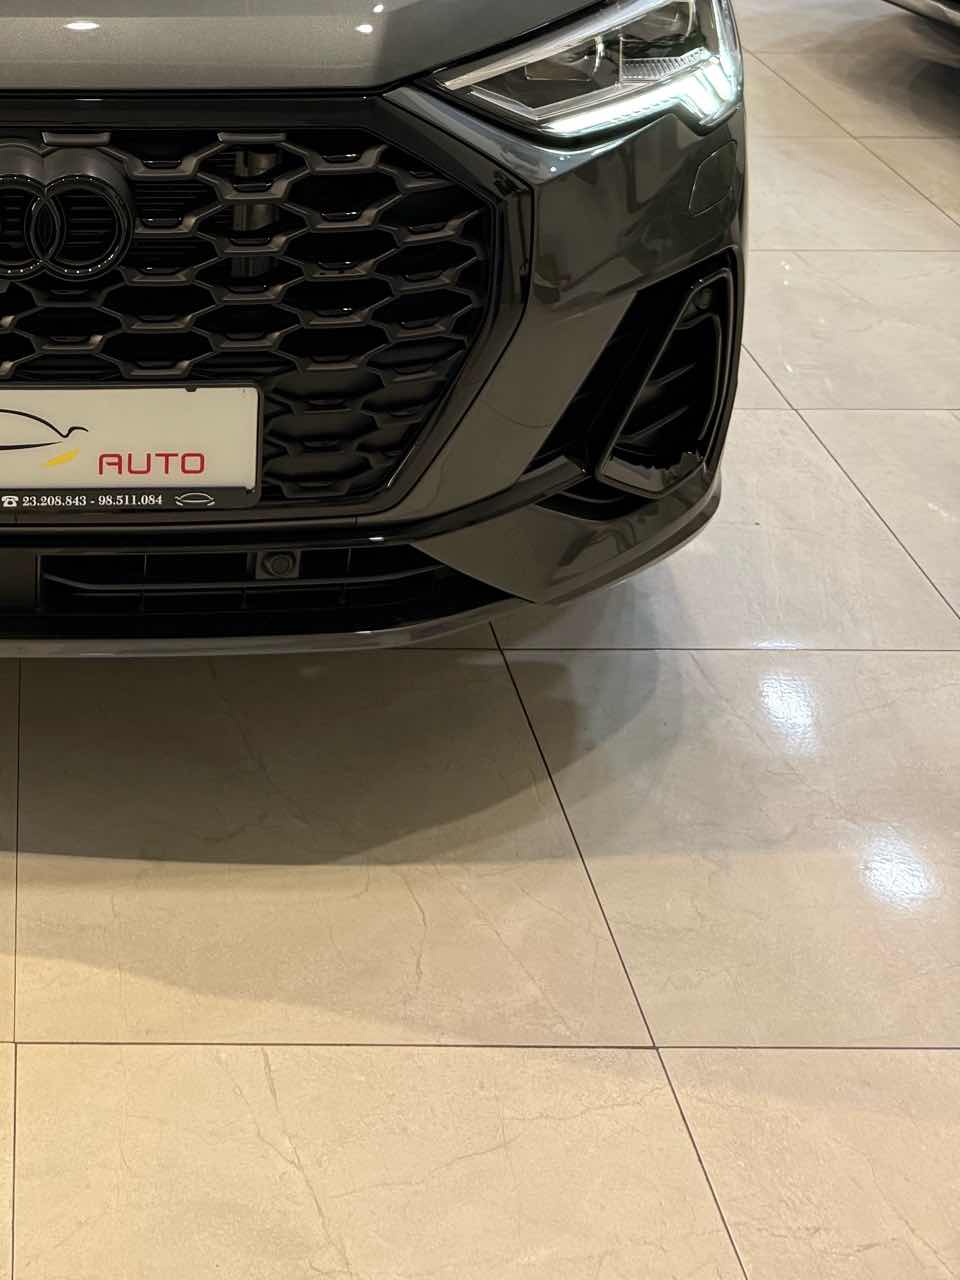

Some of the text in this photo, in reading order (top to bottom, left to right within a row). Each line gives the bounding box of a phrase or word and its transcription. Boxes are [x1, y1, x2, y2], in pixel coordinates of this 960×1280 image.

[98, 452, 206, 476] AUTO
[22, 495, 87, 508] 23.208.843
[98, 494, 163, 507] 98.511.084
